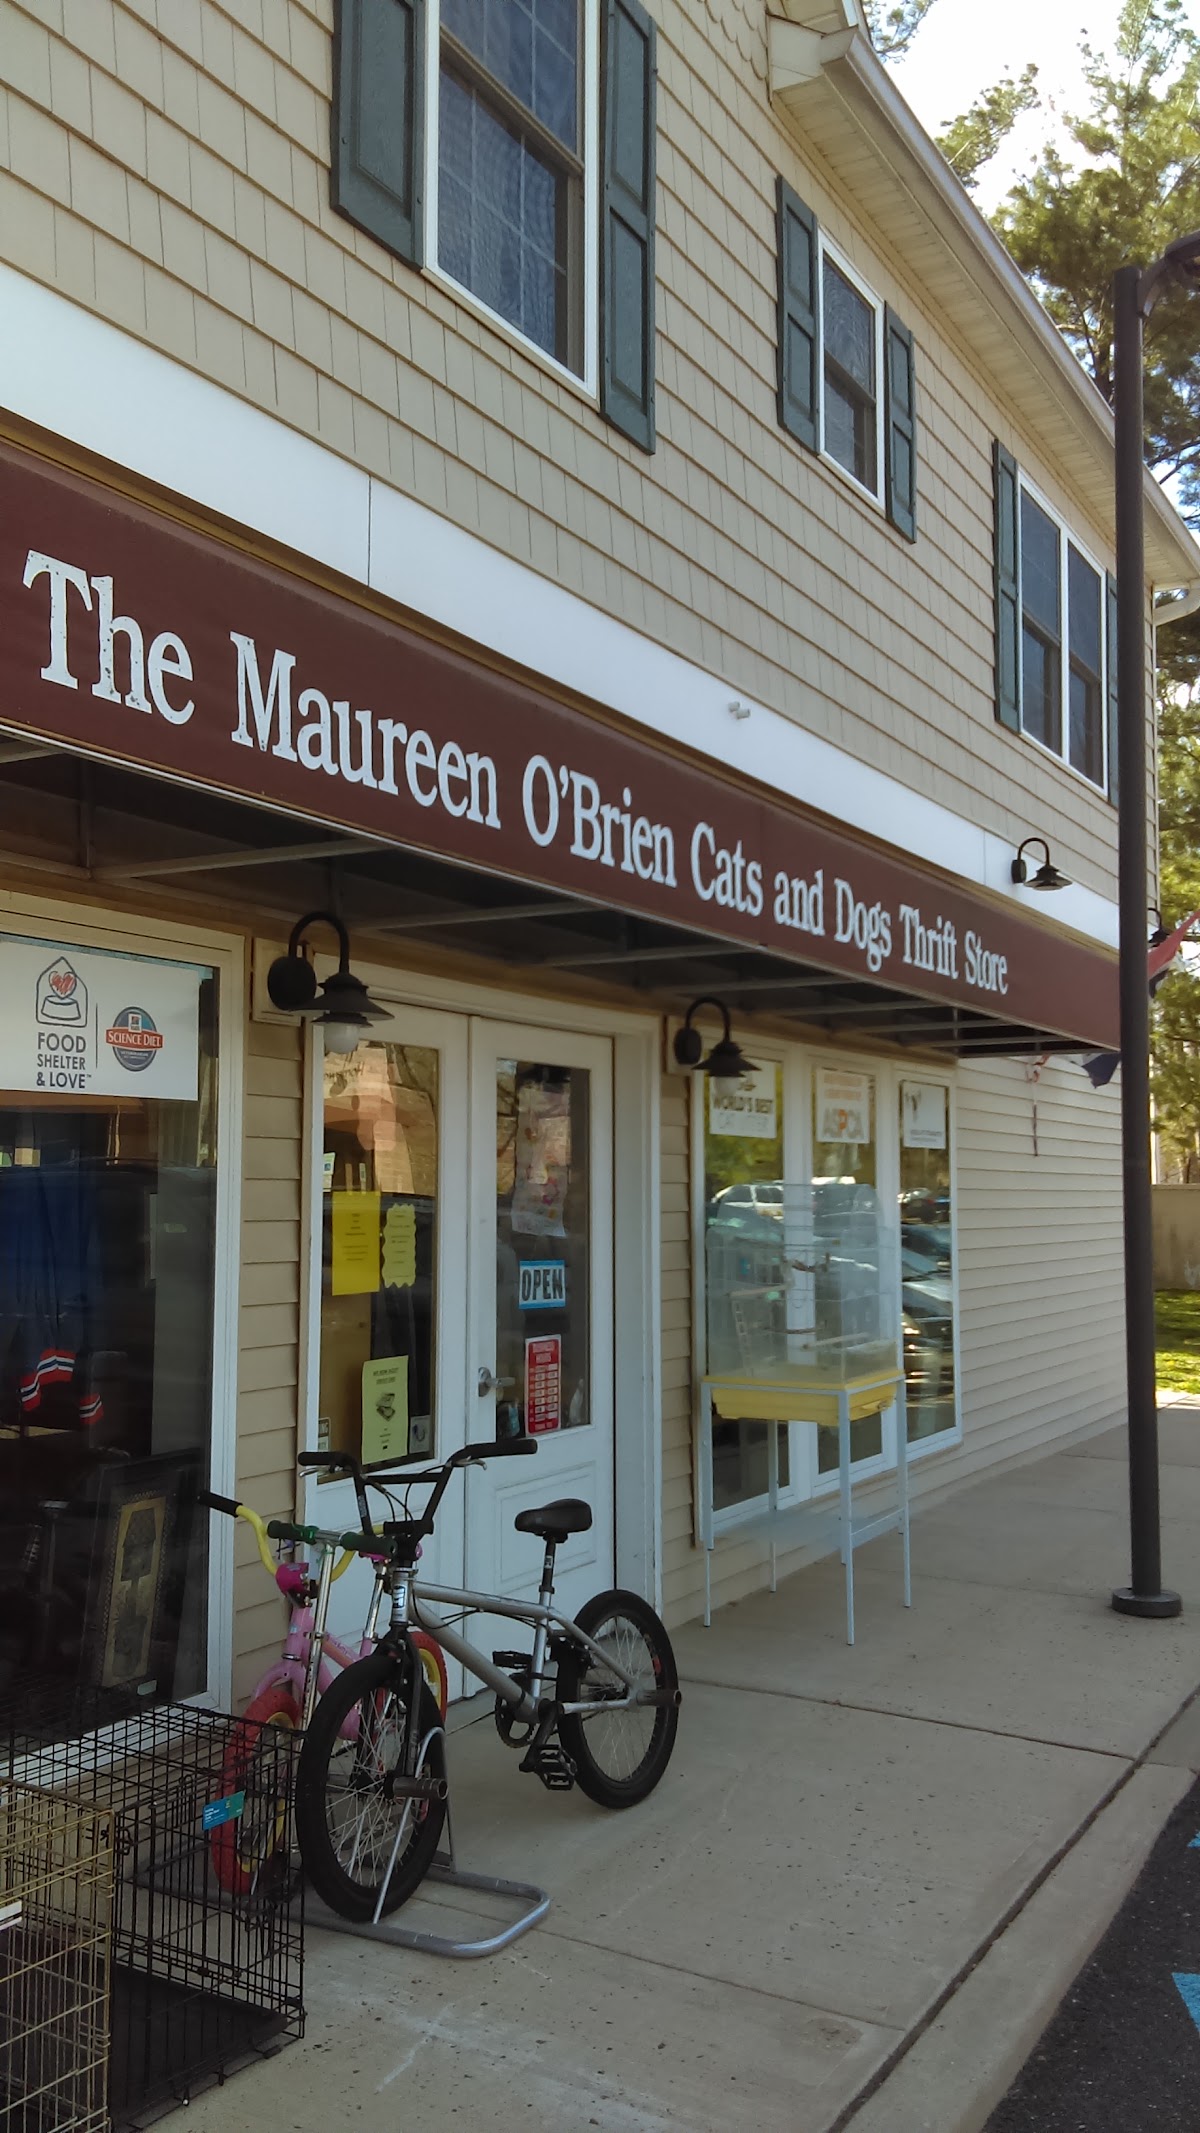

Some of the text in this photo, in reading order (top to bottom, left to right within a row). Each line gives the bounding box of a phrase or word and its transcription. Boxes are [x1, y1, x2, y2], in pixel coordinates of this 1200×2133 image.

[22, 549, 1009, 996] The Maureen O'Brien Cats and Dogs Thrift Store
[37, 1031, 87, 1054] FOOD
[108, 1030, 161, 1047] SCIENCE DIET
[36, 1053, 86, 1071] SHELTER
[36, 1071, 46, 1087] &
[521, 1268, 564, 1302] OPEN
